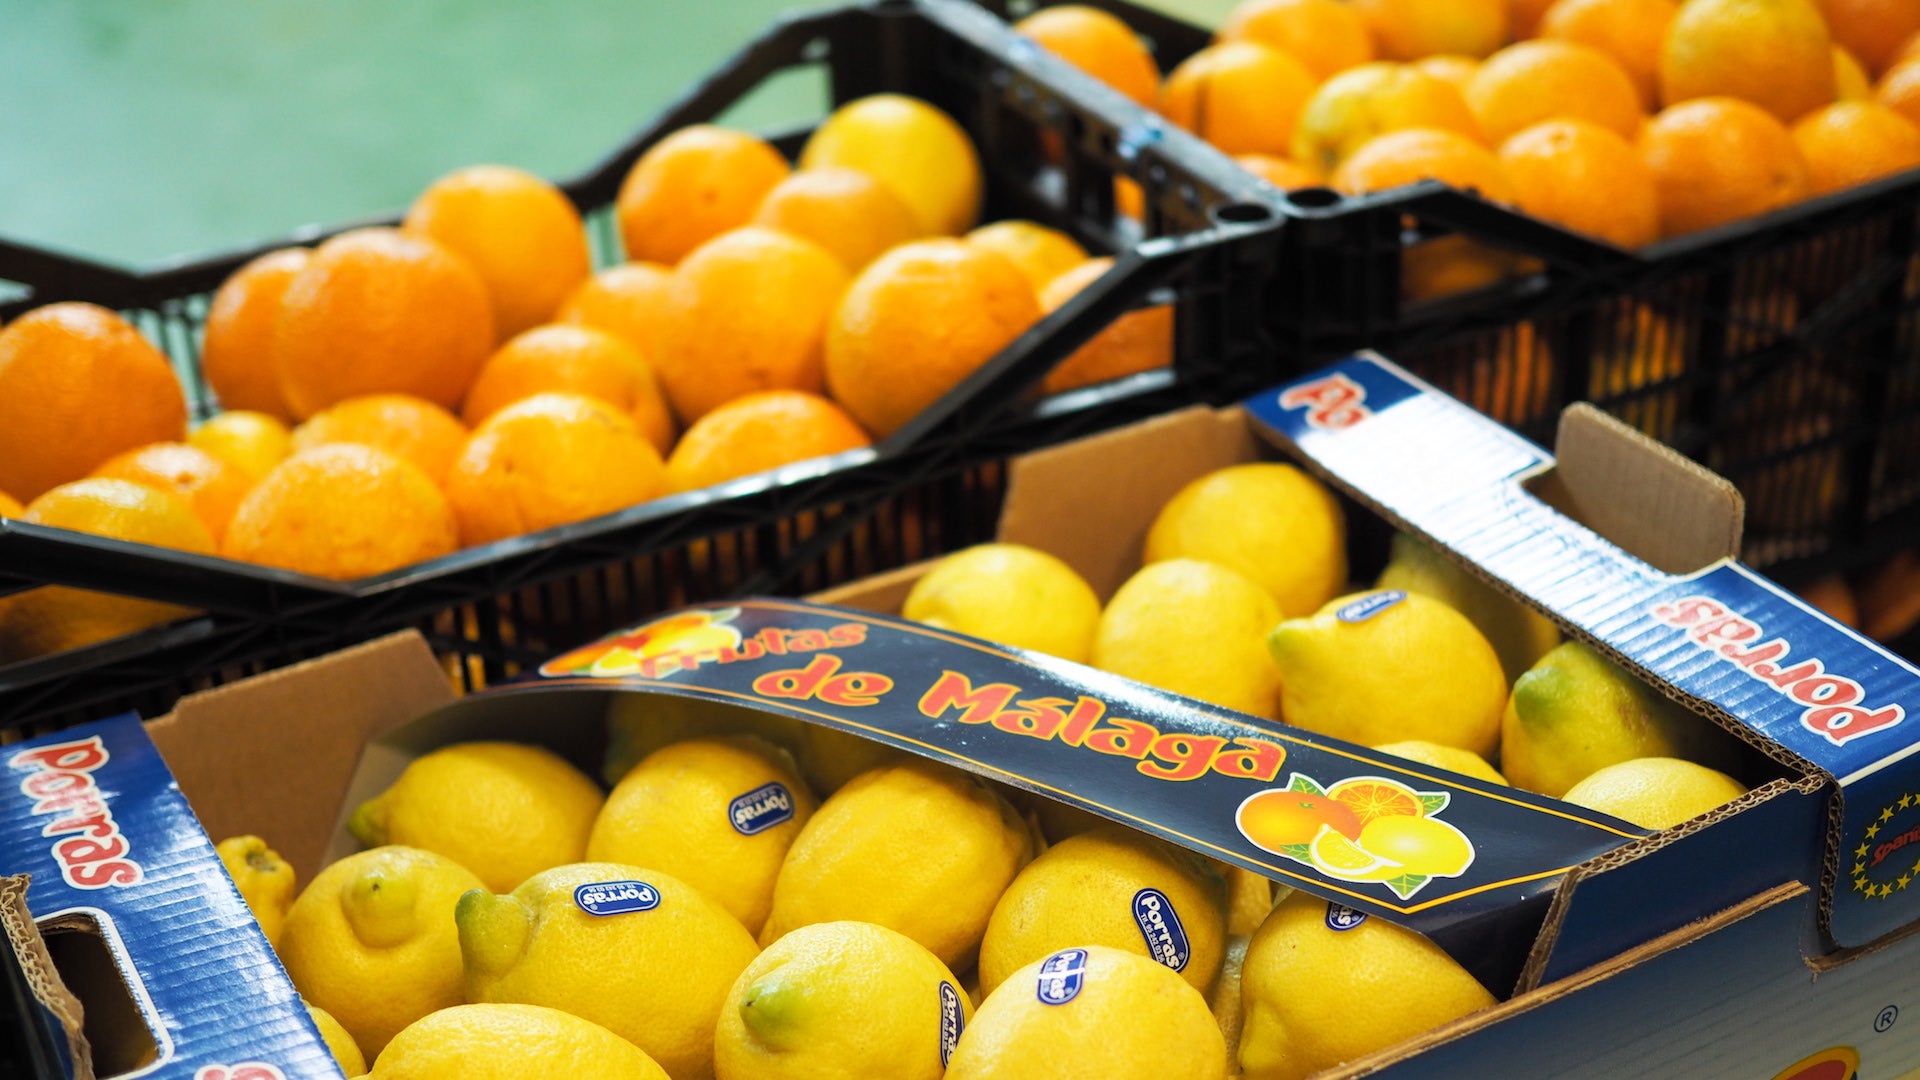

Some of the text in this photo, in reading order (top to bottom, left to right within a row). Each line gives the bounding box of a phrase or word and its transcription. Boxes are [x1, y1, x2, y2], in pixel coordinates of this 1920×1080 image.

[752, 653, 895, 707] de
[1652, 597, 1904, 746] Porras
[10, 735, 144, 890] Porras
[735, 792, 790, 824] Porras
[583, 887, 654, 905] Porras
[1141, 895, 1180, 967] Porras
